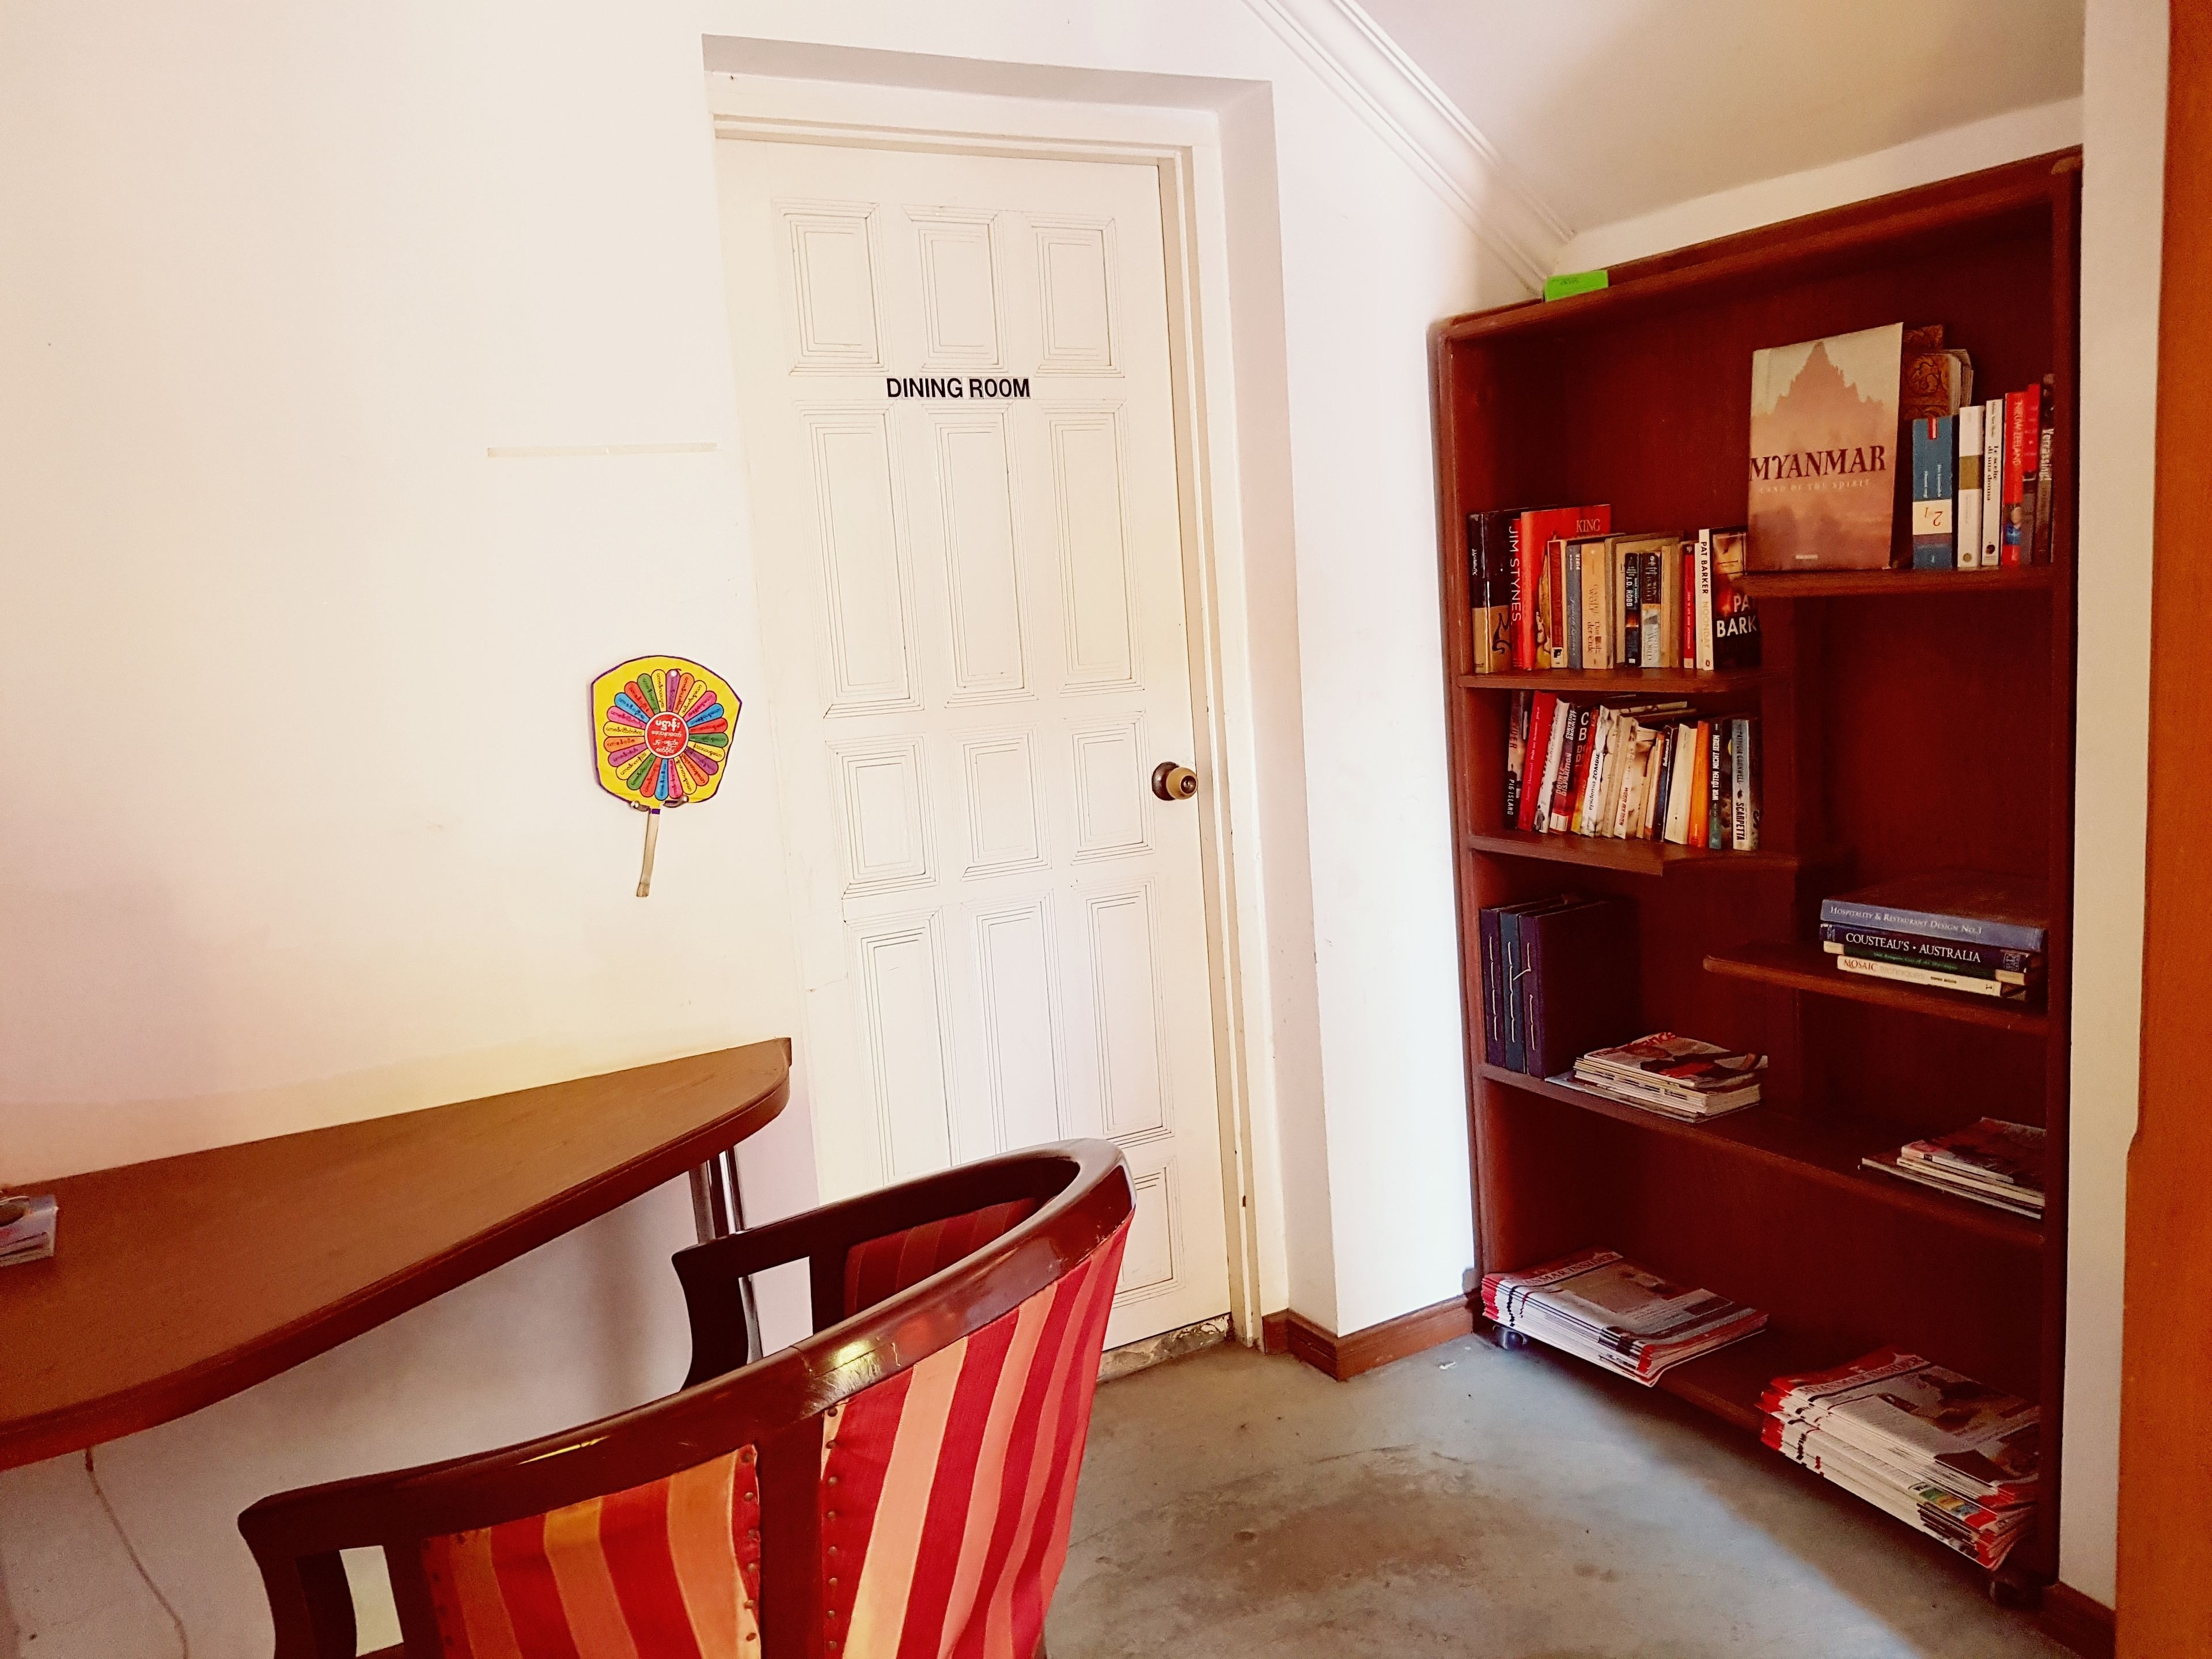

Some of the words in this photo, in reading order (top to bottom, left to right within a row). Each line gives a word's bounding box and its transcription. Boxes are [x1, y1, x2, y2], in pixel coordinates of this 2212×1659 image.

[887, 377, 963, 397] DINING
[969, 378, 1030, 397] ROOM
[1749, 445, 1885, 481] MYANMAR
[1575, 518, 1600, 532] KING
[1509, 526, 1518, 552] JIM
[1510, 559, 1522, 622] STYNES
[1733, 594, 1750, 613] PA
[1702, 601, 1710, 648] NOONDAY
[1717, 616, 1757, 638] BARK
[1712, 734, 1720, 751] JEDEN
[1589, 781, 1597, 810] epidemia
[1736, 802, 1745, 840] SCARPETTA
[1831, 906, 1873, 919] HOSPITALITY
[1874, 912, 1881, 921] &
[1883, 912, 1929, 927] RESTAURANT
[1930, 921, 1959, 931] DESIGN
[1846, 933, 1910, 951] COUSTEAU'S
[1919, 944, 1981, 963] AUSTRALIA
[1843, 959, 1878, 972] MOSAIC
